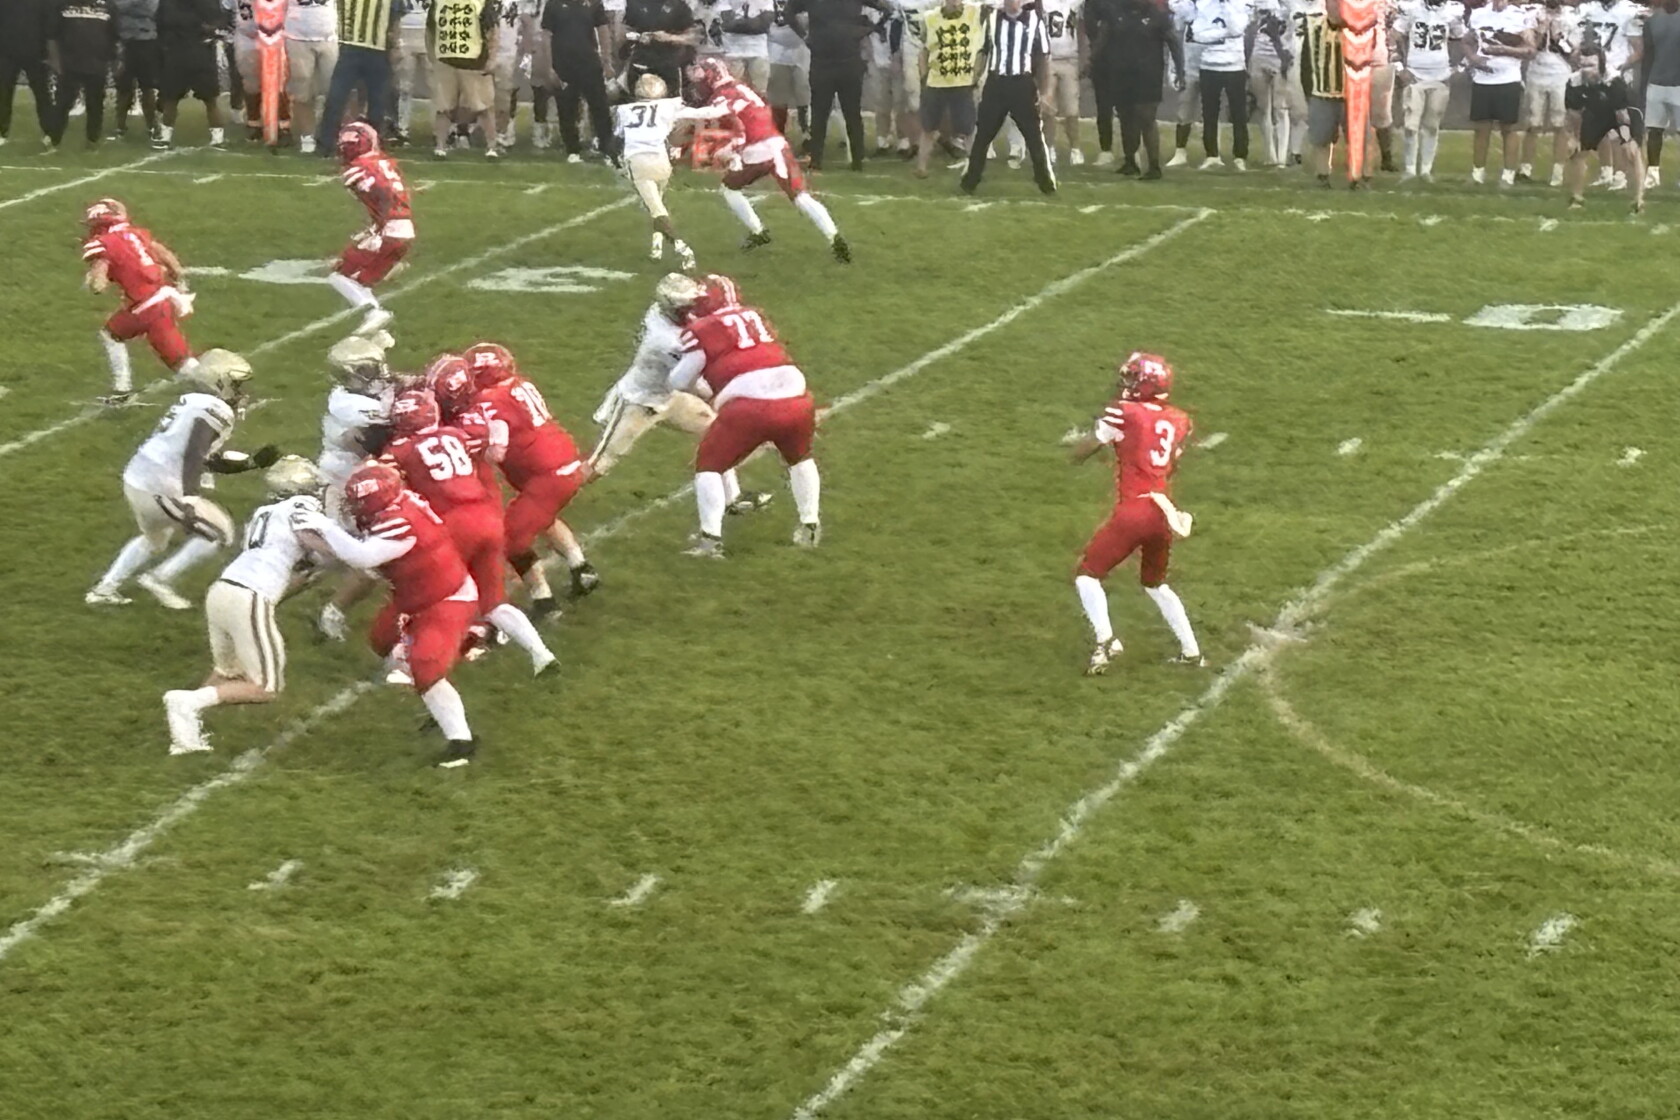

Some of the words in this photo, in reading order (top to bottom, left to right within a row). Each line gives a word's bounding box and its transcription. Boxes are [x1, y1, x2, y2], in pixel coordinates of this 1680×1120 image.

[624, 104, 658, 128] 31
[722, 310, 775, 349] 77
[416, 434, 474, 481] 58
[1149, 419, 1176, 467] 3
